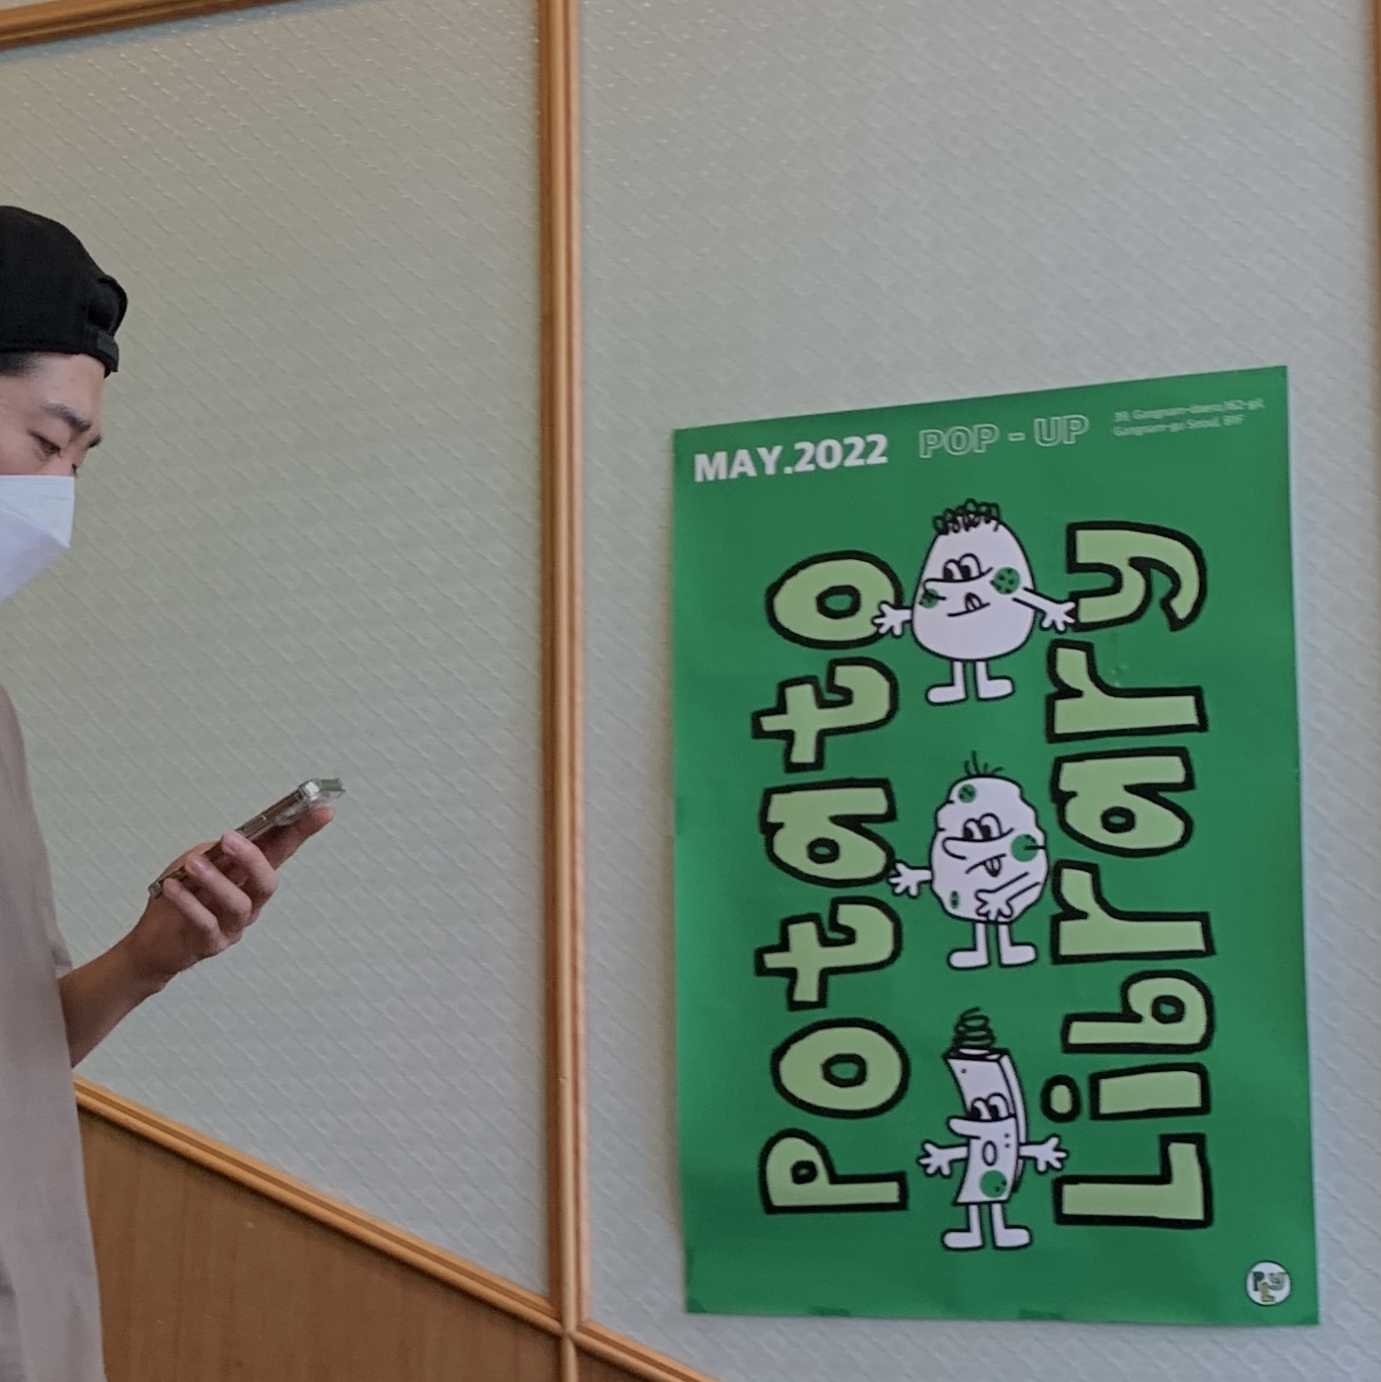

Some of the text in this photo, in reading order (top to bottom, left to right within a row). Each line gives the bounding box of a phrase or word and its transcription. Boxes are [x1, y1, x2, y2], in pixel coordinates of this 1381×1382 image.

[694, 433, 888, 482] MAY.2022
[919, 423, 1000, 459] POP
[1033, 414, 1089, 447] UP
[751, 550, 910, 1215] Potato
[1041, 521, 1216, 1228] Library
